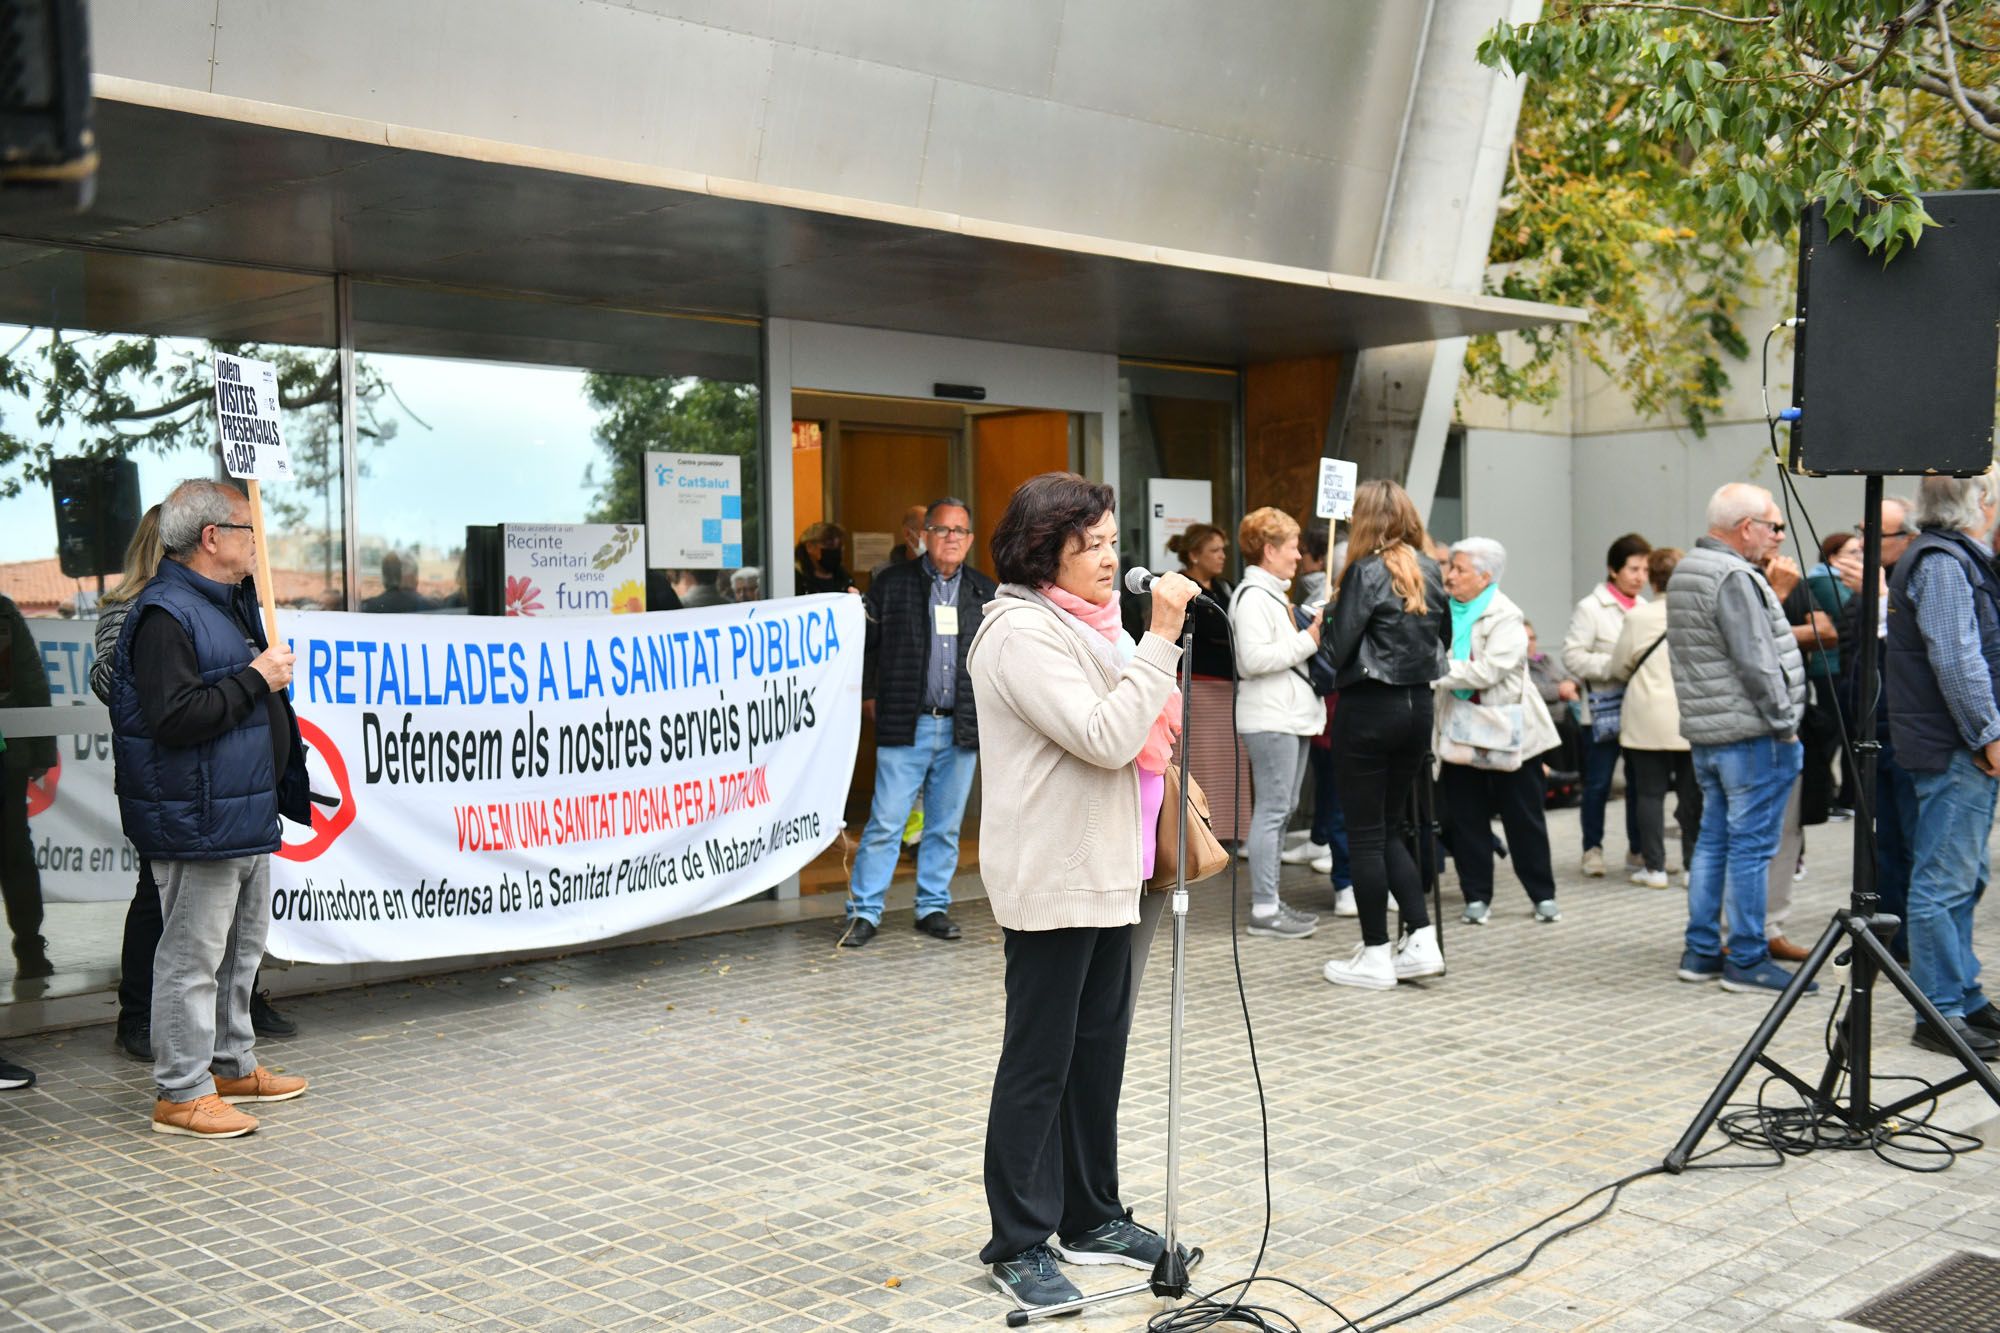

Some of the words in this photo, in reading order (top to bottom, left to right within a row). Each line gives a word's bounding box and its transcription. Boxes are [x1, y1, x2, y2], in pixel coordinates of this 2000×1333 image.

[217, 357, 241, 382] volem
[217, 380, 257, 416] VISITES
[221, 413, 280, 446] PRESENCIALS
[227, 449, 236, 471] al
[234, 442, 256, 474] CAP
[678, 475, 729, 490] CatSalut
[507, 533, 563, 549] Recinte
[531, 552, 587, 568] Sanitari
[574, 571, 605, 582] sense
[556, 582, 609, 610] fum
[309, 638, 529, 706] RETALLADES
[538, 641, 559, 702] A
[564, 639, 604, 700] LA
[609, 627, 720, 697] SANITAT
[729, 607, 840, 680] PÚBLICA
[363, 711, 503, 785] Defensem
[512, 709, 549, 779] els
[558, 705, 651, 775] nostres
[660, 689, 740, 764] serveis
[454, 802, 517, 853] VOLEM
[515, 799, 552, 850] UNA
[553, 791, 618, 845] SANITAT
[622, 785, 673, 837] DIGNA
[674, 779, 704, 827] PER
[706, 777, 716, 822] A
[384, 882, 409, 920] en
[411, 877, 493, 918] defensa
[500, 872, 522, 912] de
[526, 869, 544, 910] la
[550, 863, 613, 907] Sanitat
[615, 853, 678, 896] Pública
[681, 844, 705, 882] de
